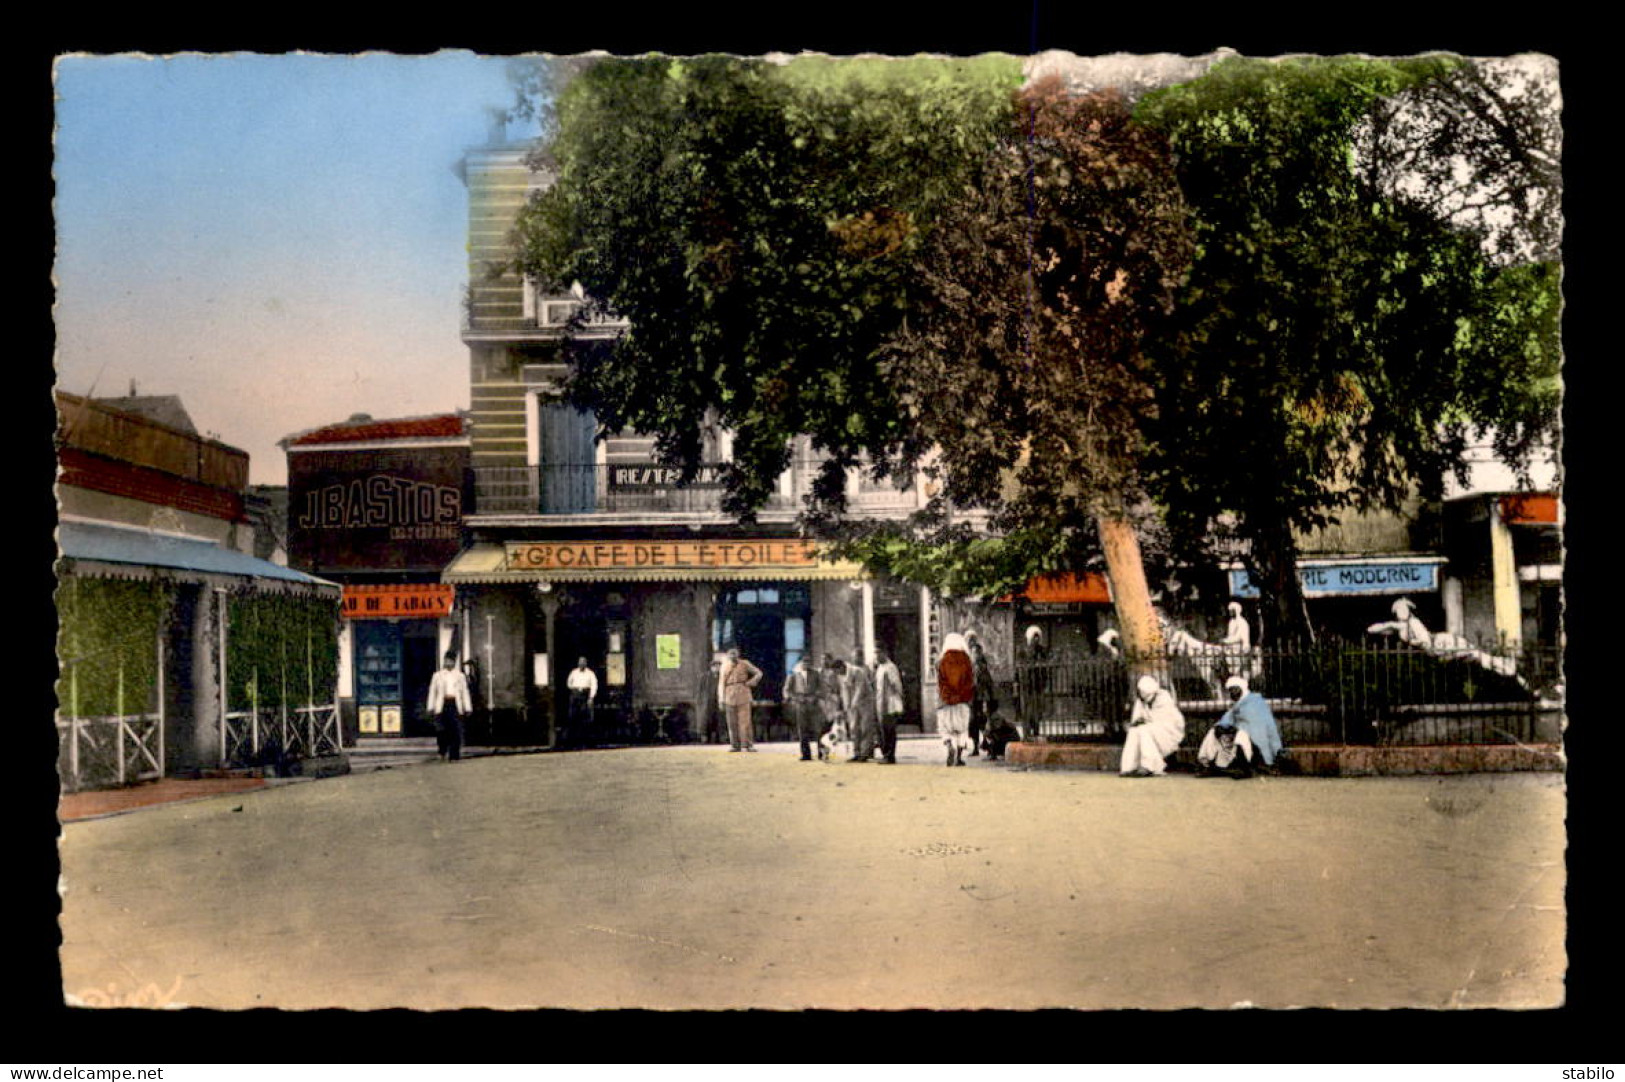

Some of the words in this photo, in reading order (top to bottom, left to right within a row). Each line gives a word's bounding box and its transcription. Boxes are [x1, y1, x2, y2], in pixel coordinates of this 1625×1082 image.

[634, 546, 665, 566] DE
[1339, 566, 1421, 585] MODERNE
[366, 597, 379, 611] DE
